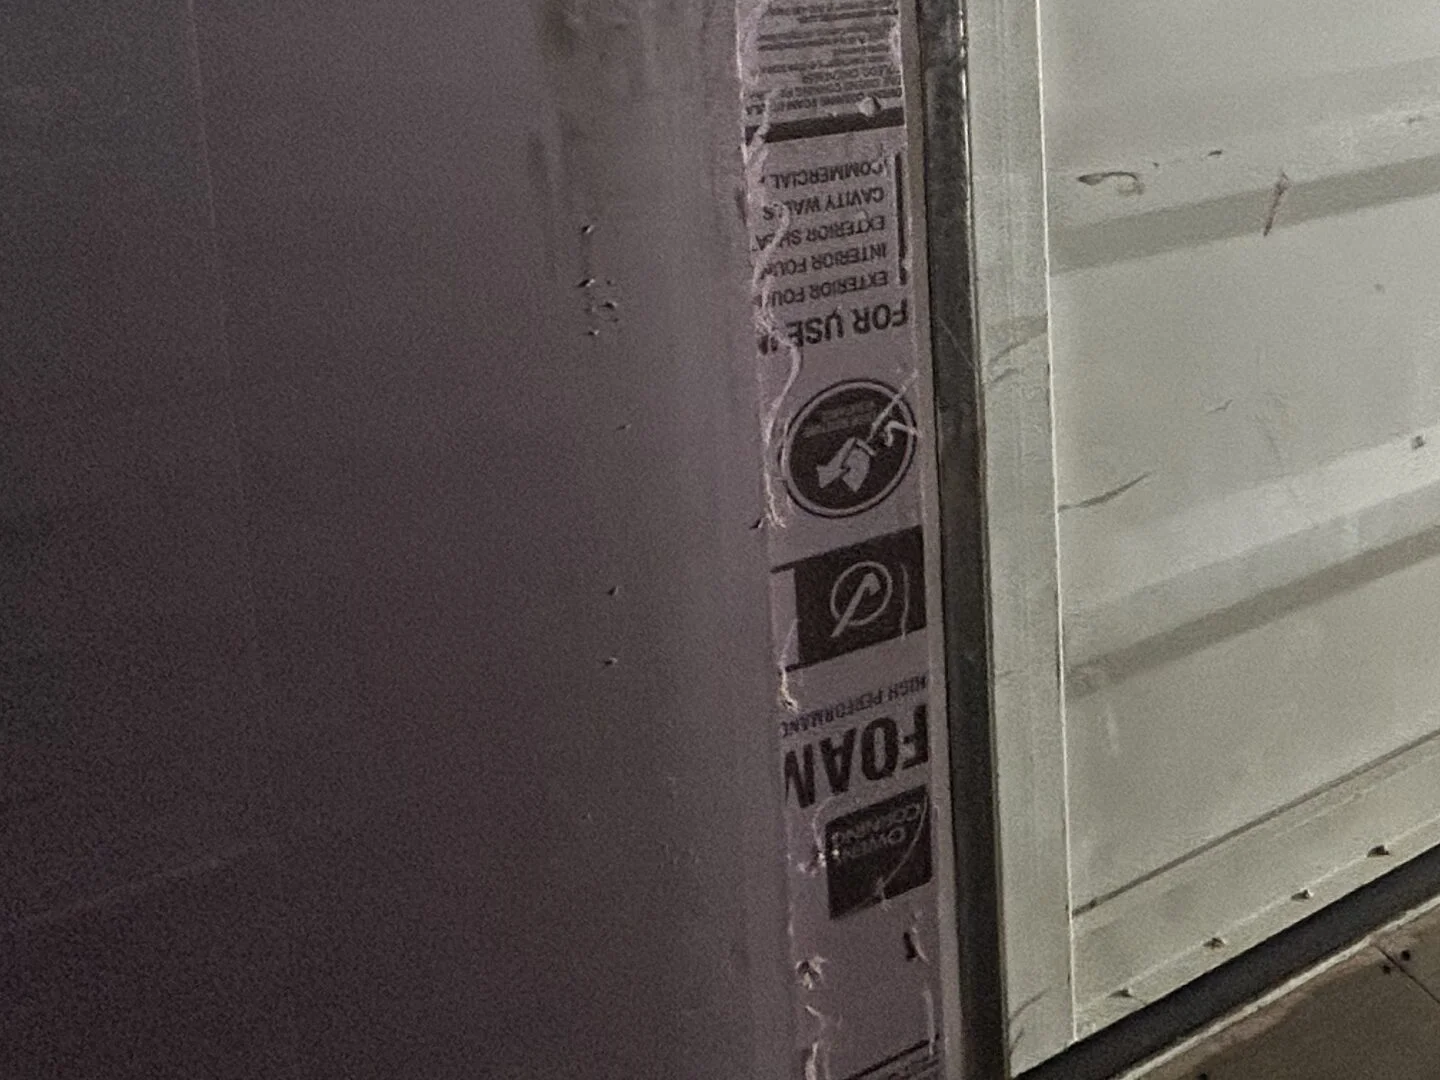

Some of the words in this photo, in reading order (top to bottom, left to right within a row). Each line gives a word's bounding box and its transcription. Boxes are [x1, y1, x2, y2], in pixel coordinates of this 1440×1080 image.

[769, 160, 884, 189] COMMERCIAL
[762, 195, 821, 221] WALS
[825, 186, 885, 212] CAVITY
[805, 215, 886, 242] EXTERIOR
[811, 242, 888, 266] INTERIOR
[808, 270, 889, 300] EXTERIOR
[785, 308, 845, 348] USE
[851, 298, 909, 335] FOR
[888, 675, 927, 702] HIGH
